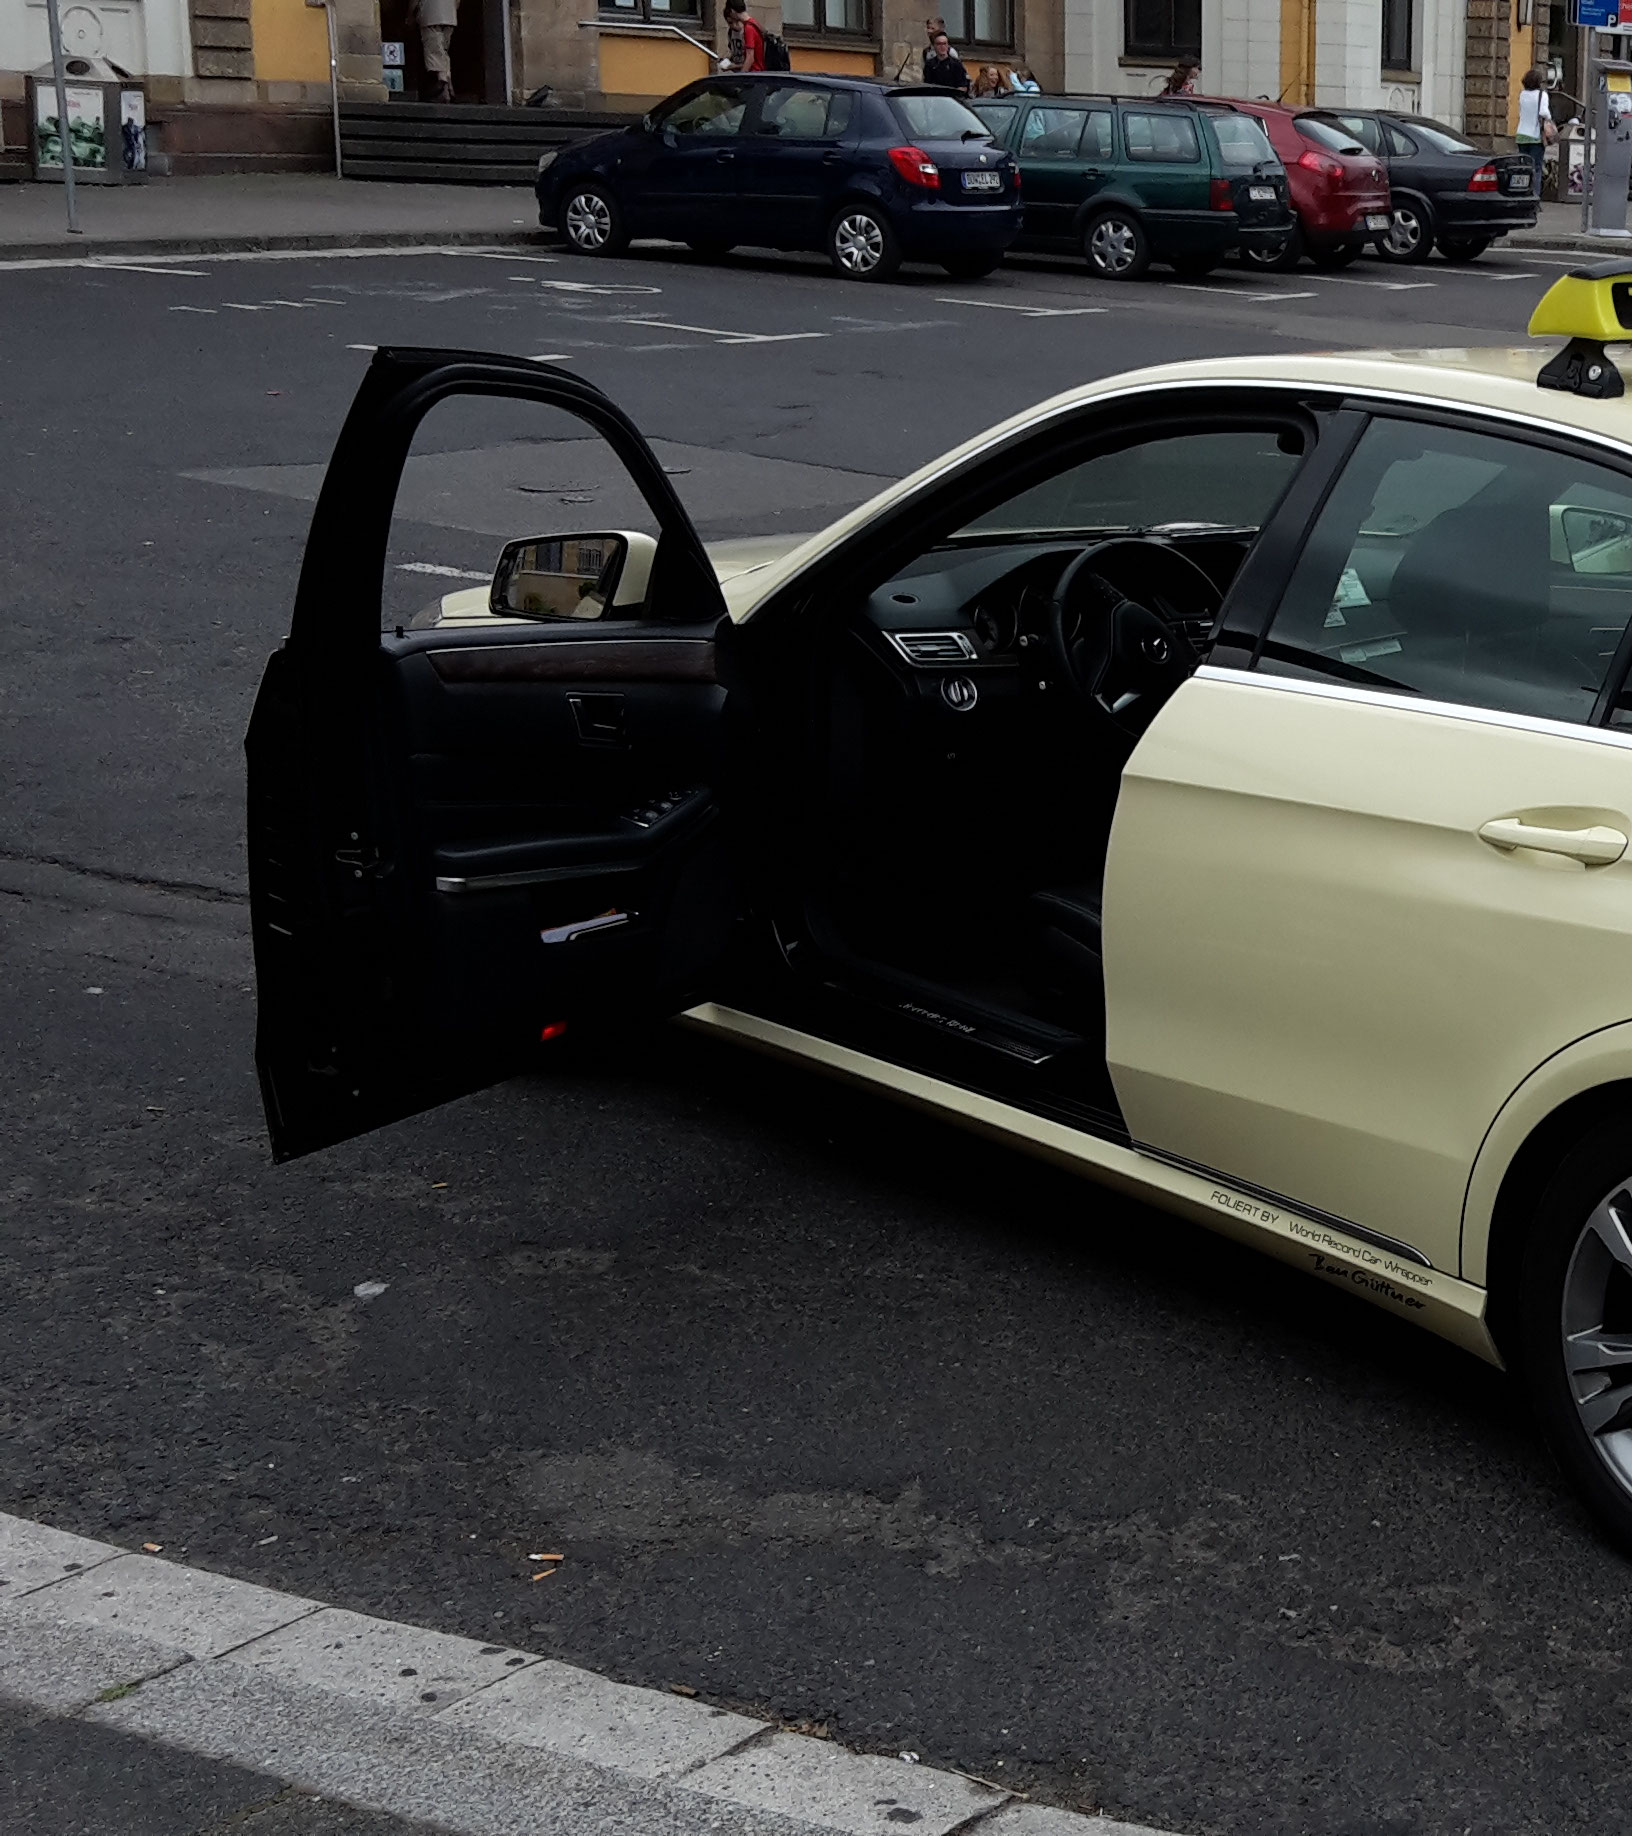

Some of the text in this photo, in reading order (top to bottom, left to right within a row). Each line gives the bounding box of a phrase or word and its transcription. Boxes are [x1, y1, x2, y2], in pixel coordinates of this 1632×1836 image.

[1260, 1210, 1280, 1224] BY
[1289, 1220, 1322, 1242] World
[1321, 1233, 1362, 1258] Record
[1362, 1249, 1382, 1265] Car
[1384, 1260, 1434, 1286] Wrapper
